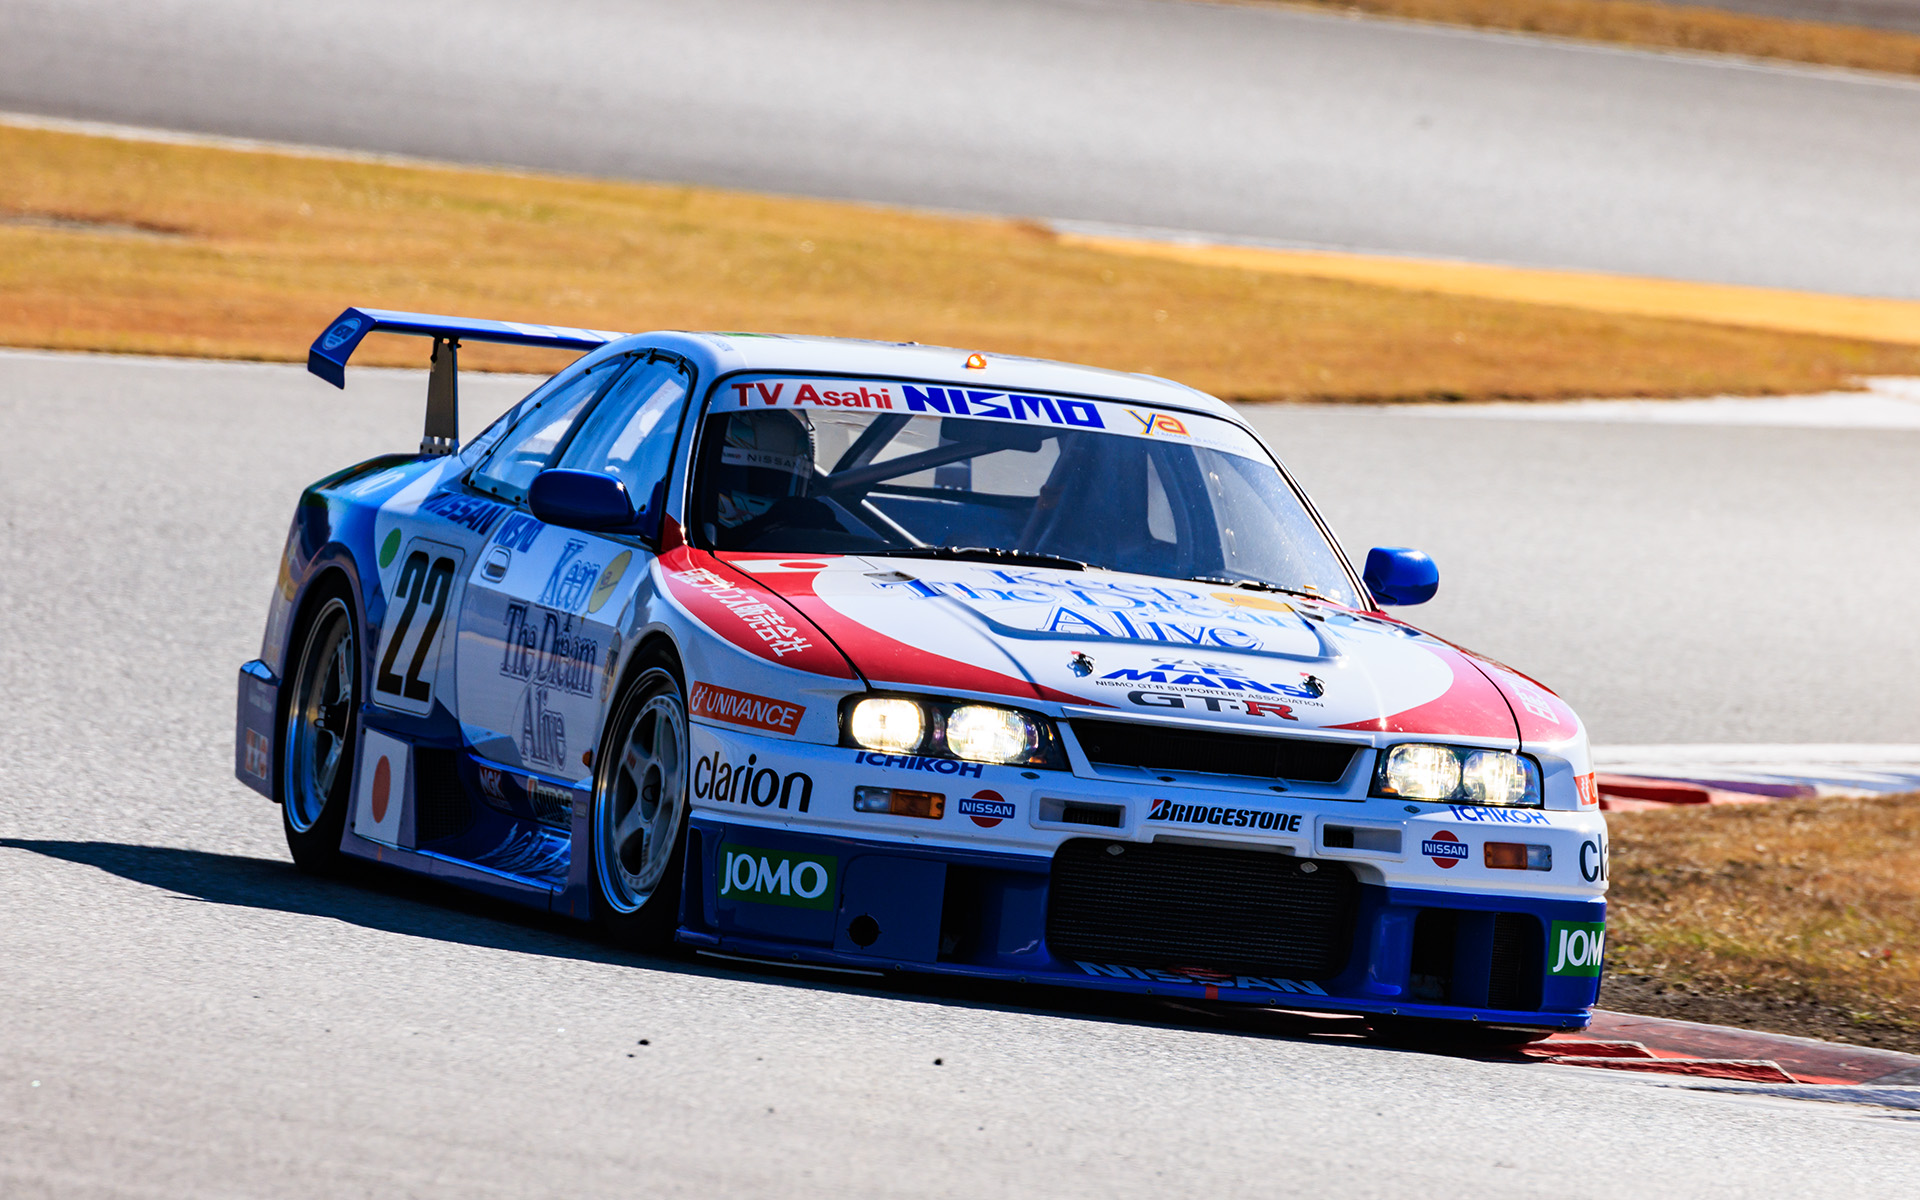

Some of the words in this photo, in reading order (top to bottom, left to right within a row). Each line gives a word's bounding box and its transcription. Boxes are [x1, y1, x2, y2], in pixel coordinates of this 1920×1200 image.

[731, 383, 784, 407] TV
[793, 384, 893, 410] Asahi
[901, 385, 1106, 430] NISMO
[419, 491, 507, 536] NISSAN
[493, 512, 548, 554] NISMO
[538, 537, 601, 632] Keep
[872, 578, 1061, 604] The
[376, 550, 456, 703] 22
[1036, 604, 1264, 650] Alive
[500, 599, 539, 682] The
[533, 602, 599, 699] Dream
[1099, 669, 1317, 699] MANS
[1153, 664, 1249, 679] LE
[706, 688, 799, 728] UNIVANCE
[1095, 680, 1134, 688] NISMO
[1168, 686, 1244, 698] SUPPORTERS
[1248, 693, 1325, 708] ASSOCIATION
[520, 682, 567, 772] Alive
[694, 751, 814, 813] clarion
[855, 751, 984, 778] ICHIKOH
[480, 765, 506, 801] NGK
[961, 801, 1013, 816] NISSAN
[1147, 799, 1302, 833] BRIDGESTONE
[1448, 805, 1552, 826] ICHIKOH
[1424, 842, 1467, 857] NISSAN
[720, 851, 829, 899] JOMO
[1074, 960, 1329, 996] NISSAN
